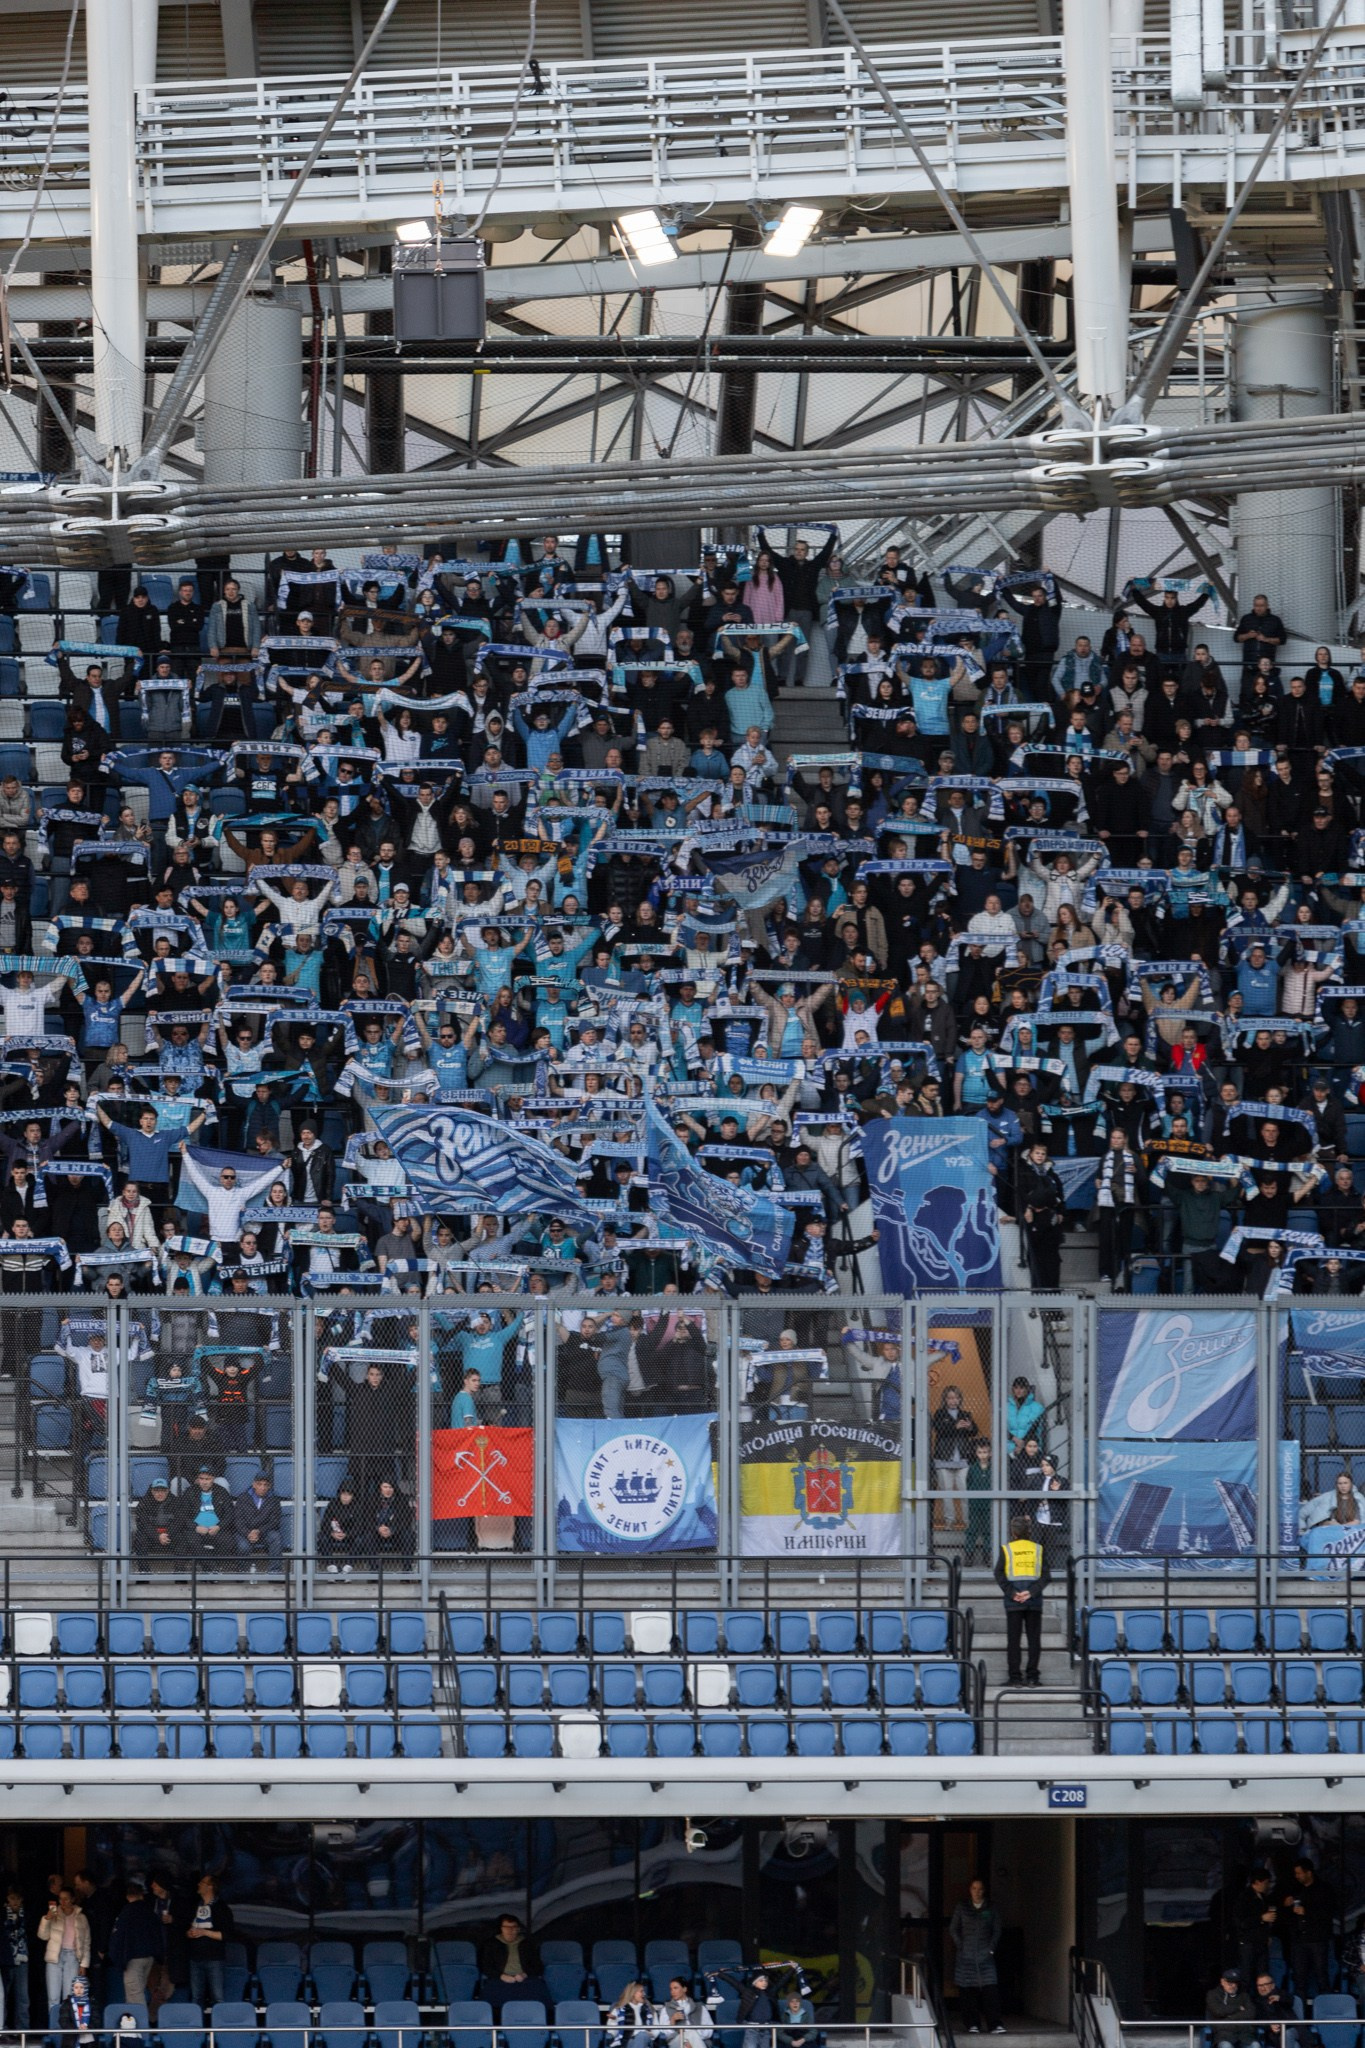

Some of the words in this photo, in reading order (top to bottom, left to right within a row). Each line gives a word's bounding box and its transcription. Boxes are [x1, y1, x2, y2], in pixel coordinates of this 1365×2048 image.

[503, 645, 544, 658] ZENIT
[866, 708, 898, 719] ЗЕНИТ
[238, 744, 293, 753] ЗЕНИТ
[503, 841, 519, 851] 20
[542, 841, 557, 852] 25
[605, 843, 658, 851] ЗЕНИТ
[987, 839, 1002, 848] 25
[880, 861, 936, 870] ЗЕНИТ
[661, 879, 707, 890] ЗЕНИ
[137, 916, 186, 924] ZENIT
[242, 986, 293, 994] ЗЕНИТ
[354, 1003, 402, 1011] ZENIT
[282, 1011, 334, 1019] ЗЕНИТ
[871, 1042, 923, 1050] ЗЕНИТ
[737, 1058, 753, 1067] ФК
[755, 1059, 789, 1070] ЗЕНИТ
[1152, 1140, 1167, 1149] 20
[1191, 1144, 1206, 1154] 25
[877, 1130, 975, 1184] Зенит
[944, 1156, 973, 1168] 1925
[48, 1163, 100, 1173] ZENIT
[1302, 1249, 1361, 1259] ЗЕНИТ
[1127, 1314, 1258, 1432] Зенит
[589, 1454, 610, 1498] ЗЕНИТ
[624, 1439, 668, 1458] ПИТЕР
[1099, 1449, 1180, 1489] Зенит
[606, 1513, 647, 1533] ЗЕНИТ
[663, 1475, 683, 1517] ПИТЕР
[1062, 1791, 1085, 1803] 208
